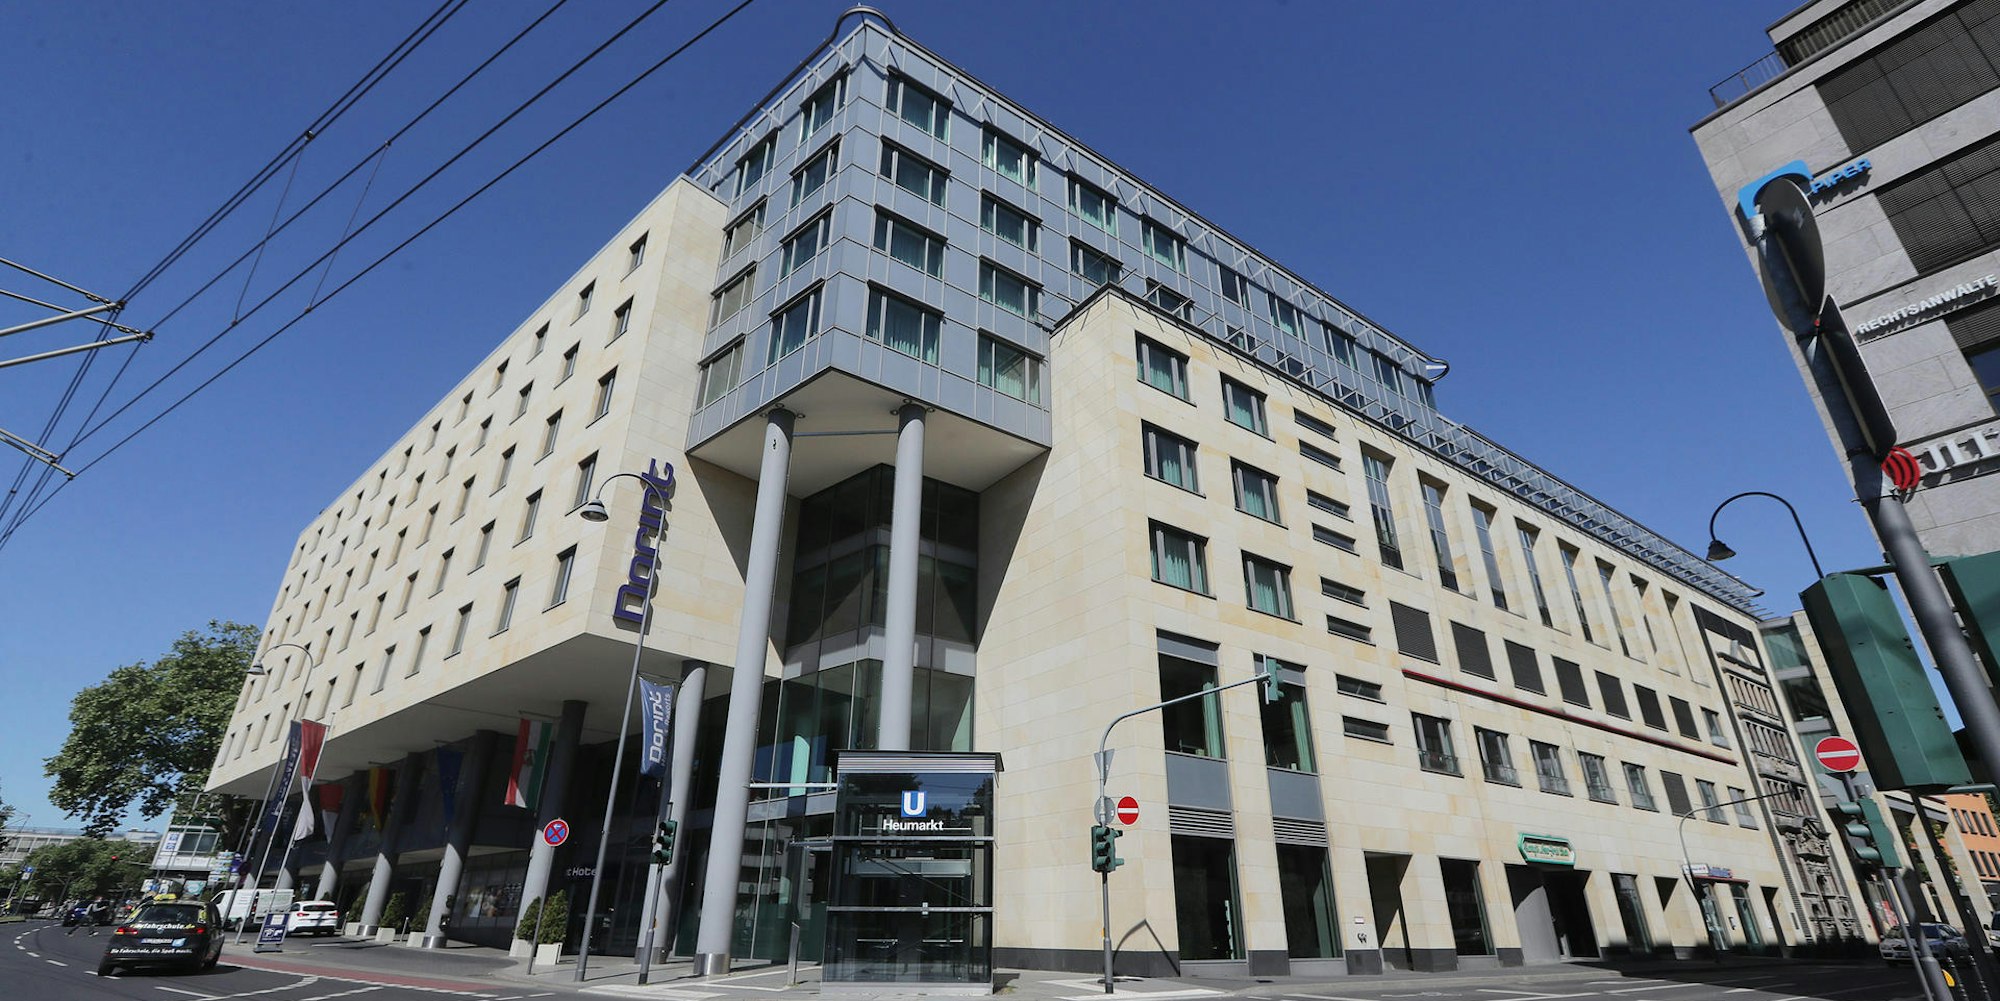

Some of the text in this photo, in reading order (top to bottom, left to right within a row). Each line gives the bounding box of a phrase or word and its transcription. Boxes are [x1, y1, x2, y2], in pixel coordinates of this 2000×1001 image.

[1810, 159, 1872, 193] PIPER
[1857, 274, 1999, 334] RECHTSANWÄLTE
[614, 458, 674, 623] Dorint
[649, 690, 664, 764] Dorint
[903, 792, 925, 816] U
[882, 819, 944, 831] Heumarkt
[572, 867, 598, 877] Hote
